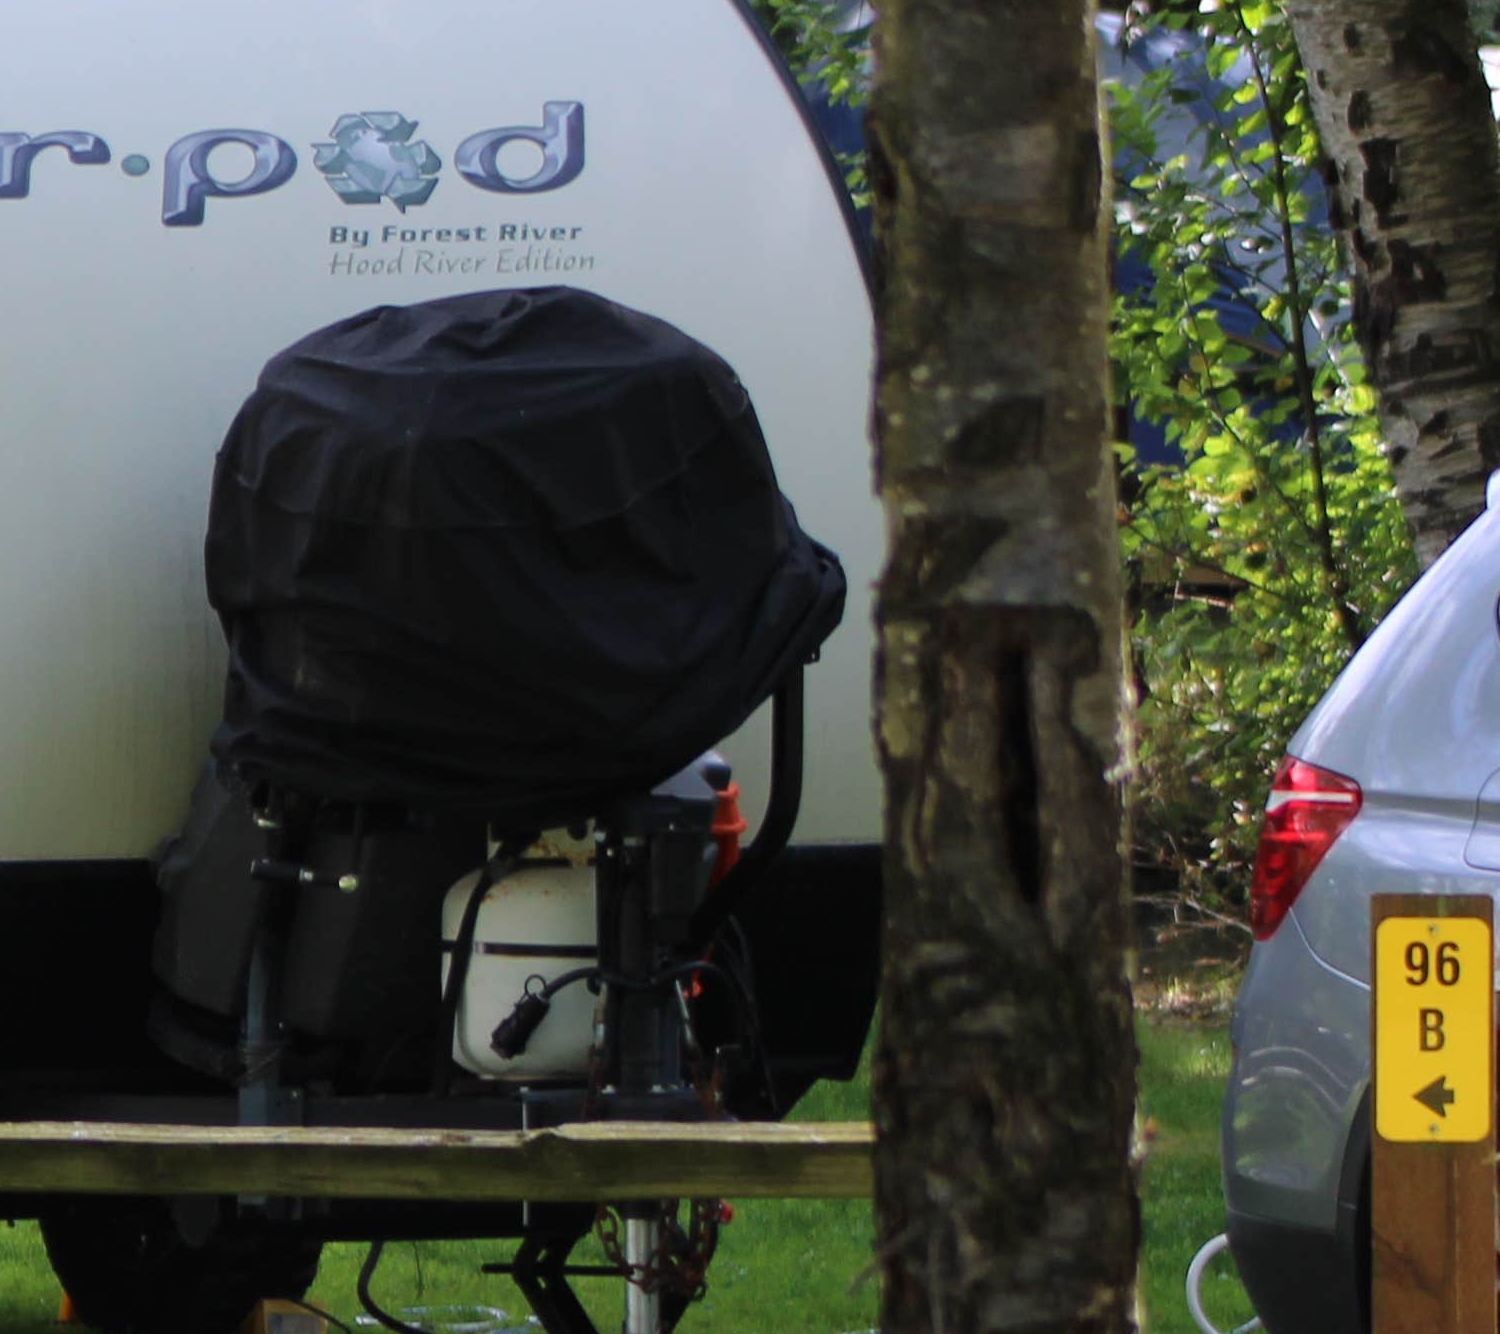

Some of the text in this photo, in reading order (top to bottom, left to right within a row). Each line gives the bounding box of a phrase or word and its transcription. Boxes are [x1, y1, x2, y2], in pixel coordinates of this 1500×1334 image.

[329, 223, 583, 248] By Forest River
[328, 246, 595, 276] Hood River Edition
[1404, 941, 1460, 987] 96
[1418, 1008, 1445, 1052] B
